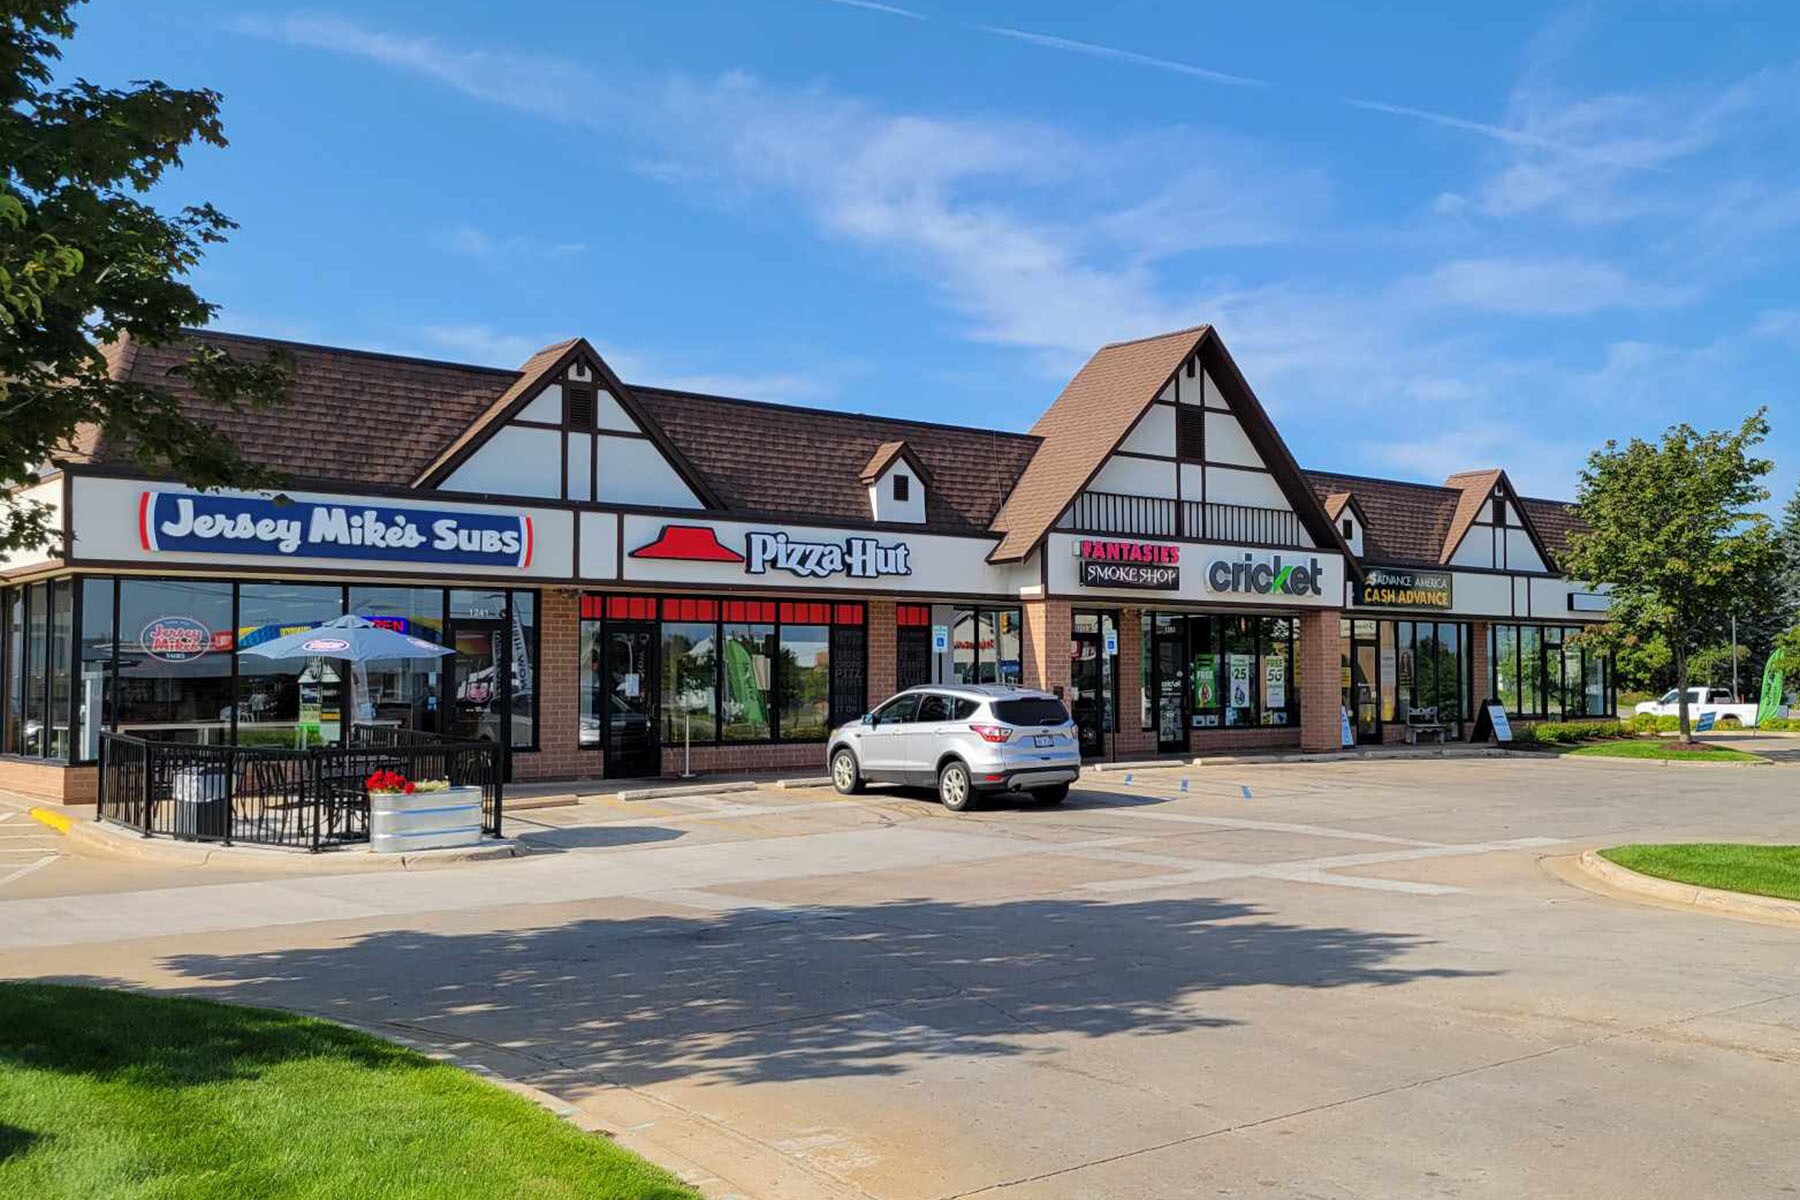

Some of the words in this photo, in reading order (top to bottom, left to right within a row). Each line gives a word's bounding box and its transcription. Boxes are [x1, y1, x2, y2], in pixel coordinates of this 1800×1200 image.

[161, 498, 301, 553] Jersey
[308, 507, 427, 549] Mike's
[747, 533, 844, 577] Pizza
[845, 538, 910, 578] Hut
[1081, 540, 1180, 564] FANTASIES
[1087, 565, 1138, 583] SMOKE
[1140, 568, 1177, 585] SHOP
[1208, 552, 1323, 597] cricket
[1414, 577, 1448, 589] AMERICA
[1364, 587, 1396, 603] CASH
[1398, 589, 1449, 606] ADVANCE
